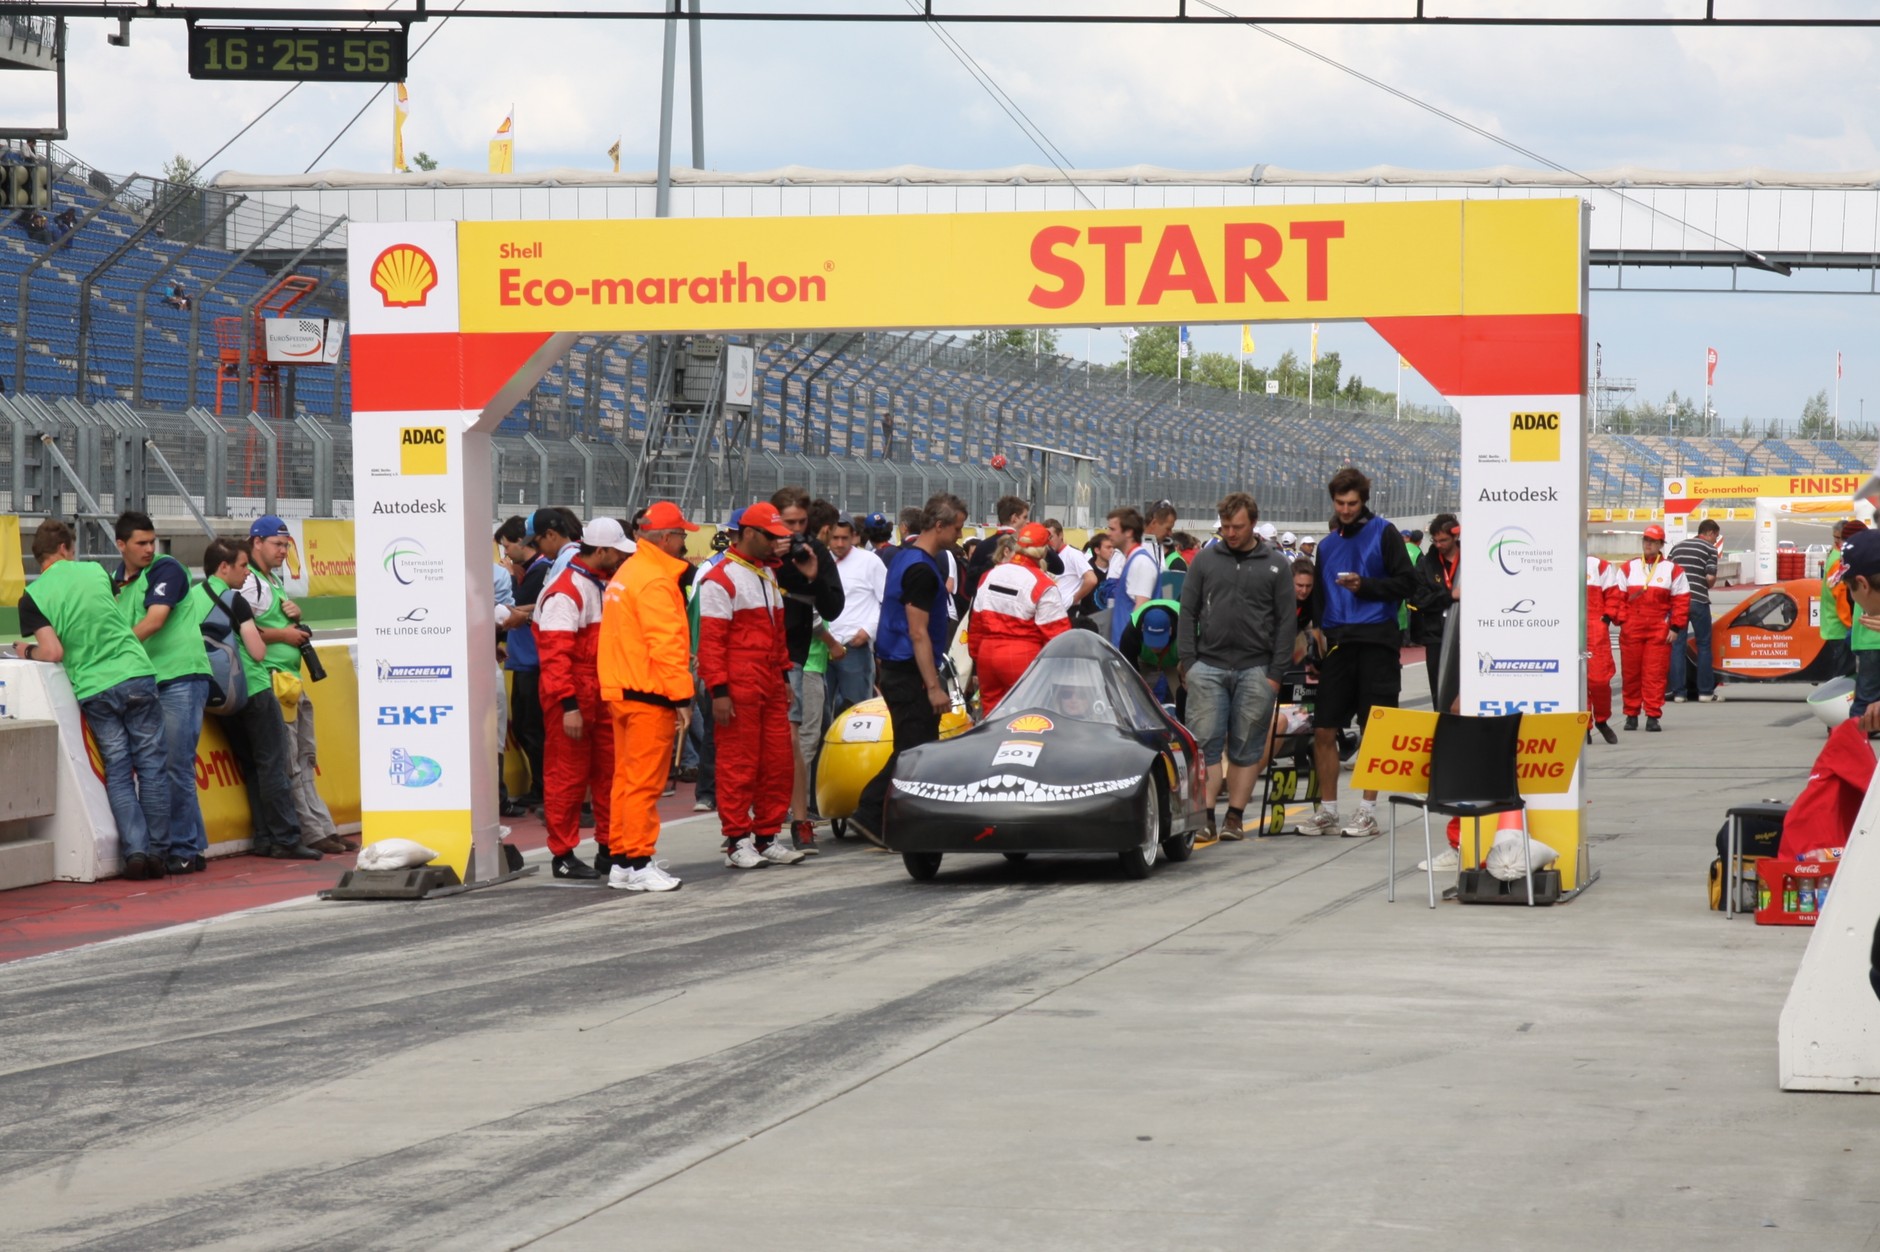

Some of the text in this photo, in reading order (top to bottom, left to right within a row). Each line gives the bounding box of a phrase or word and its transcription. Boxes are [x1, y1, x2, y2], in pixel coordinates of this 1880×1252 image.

[500, 242, 542, 259] Shell
[1028, 220, 1345, 309] START
[1512, 414, 1559, 430] ADAC
[402, 428, 445, 445] ADAC
[1789, 477, 1859, 494] FINISH
[1478, 486, 1559, 502] Autodesk
[372, 498, 447, 514] Autodesk
[375, 626, 452, 635] THE LINDE GROUP
[1477, 619, 1560, 628] THE LINDE GROUP
[391, 667, 450, 676] MICHELIN
[1494, 661, 1557, 670] MICHELIN
[377, 705, 454, 725] SKF
[1478, 700, 1559, 716] SKF
[852, 721, 872, 729] 91
[998, 749, 1034, 759] 501
[1367, 758, 1414, 776] FOR
[1270, 770, 1297, 801] 34
[1270, 804, 1285, 834] 6
